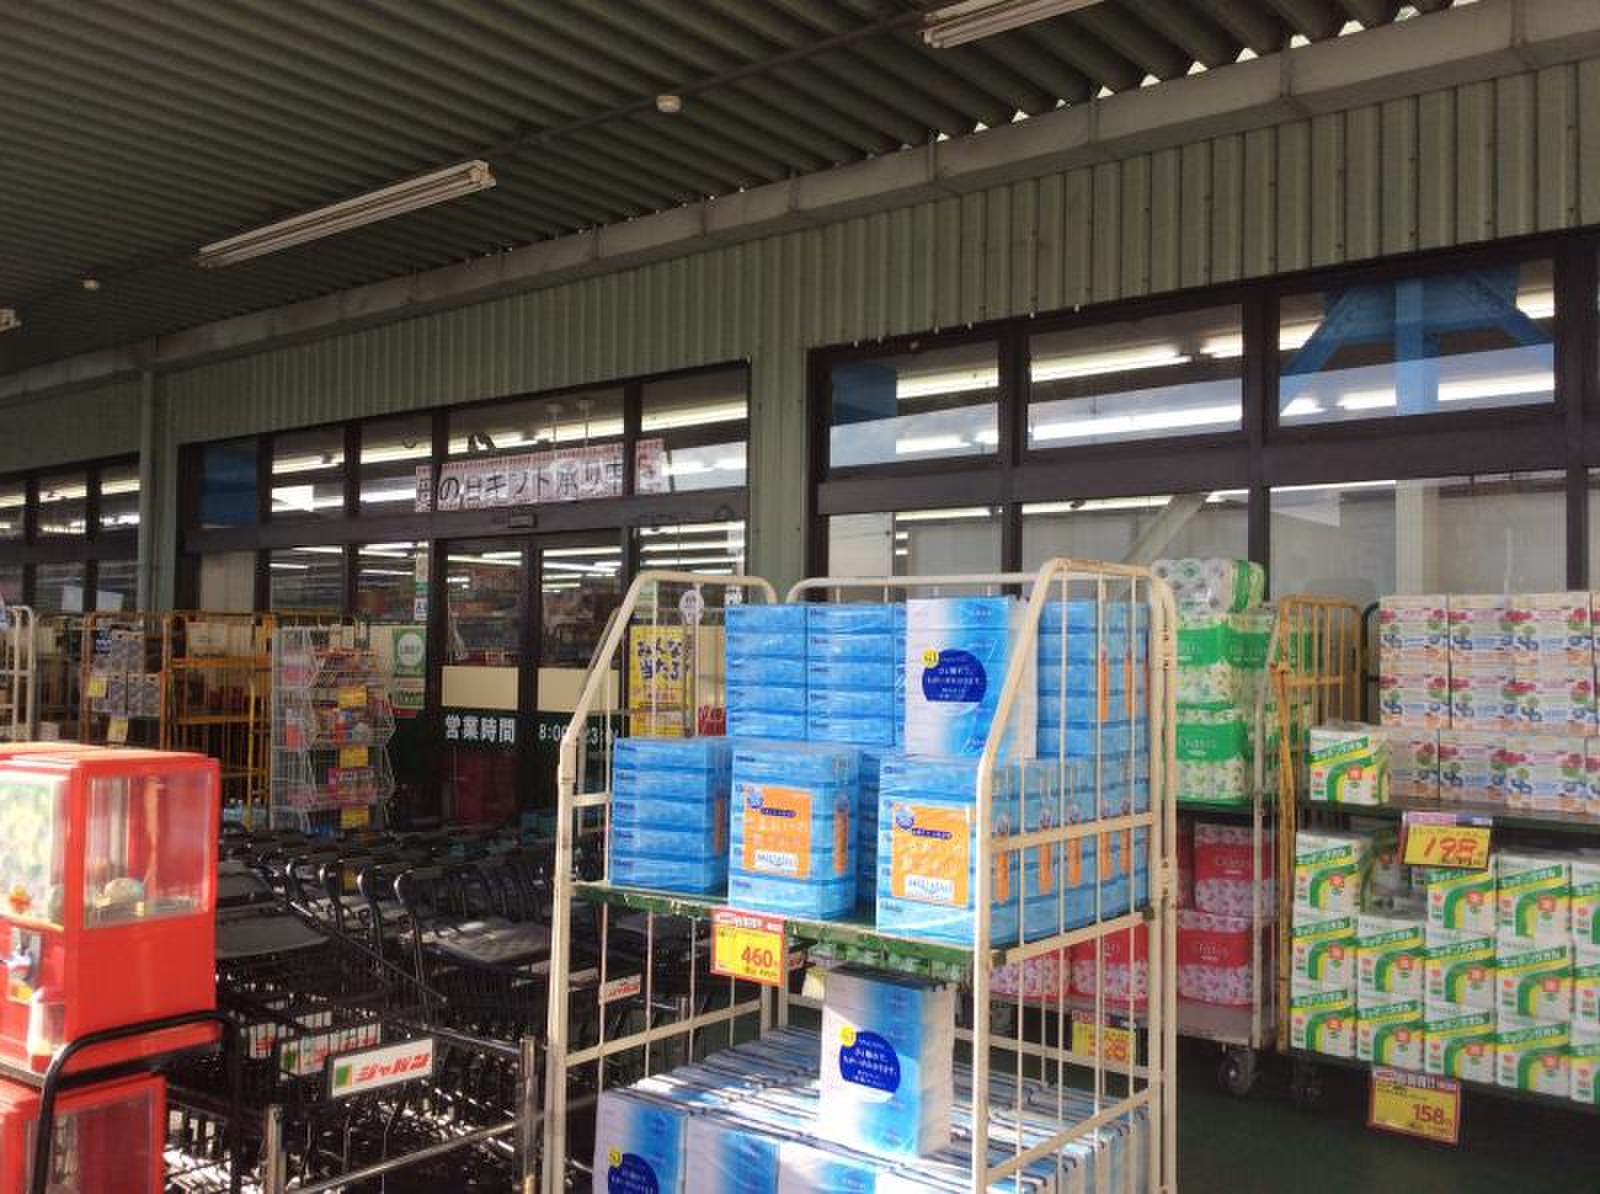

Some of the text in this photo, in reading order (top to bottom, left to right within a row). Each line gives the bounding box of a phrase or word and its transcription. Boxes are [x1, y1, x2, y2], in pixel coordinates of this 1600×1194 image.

[445, 714, 516, 744] 営業時間
[1411, 1103, 1445, 1125] 158
